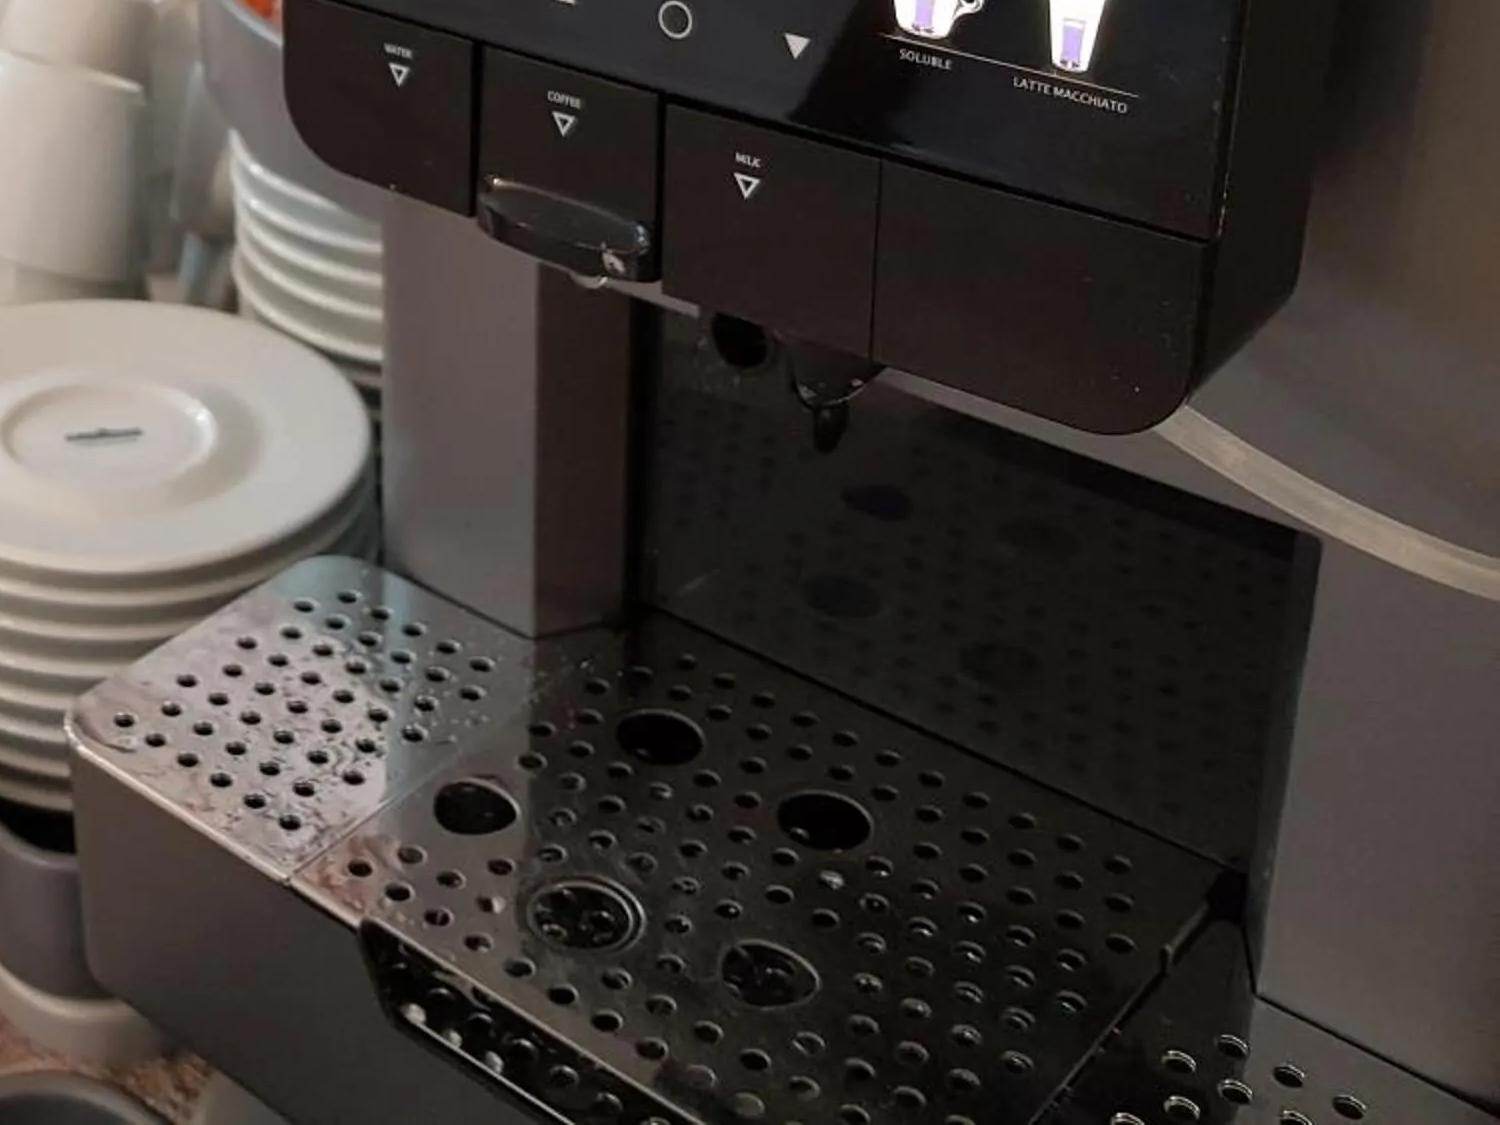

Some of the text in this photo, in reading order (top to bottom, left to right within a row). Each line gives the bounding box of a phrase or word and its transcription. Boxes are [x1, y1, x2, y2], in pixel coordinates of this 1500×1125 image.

[899, 49, 952, 71] SOLUBLE
[547, 90, 581, 110] COFFEE
[1013, 77, 1127, 115] LATTE MACCHIATO
[735, 151, 761, 169] MILK
